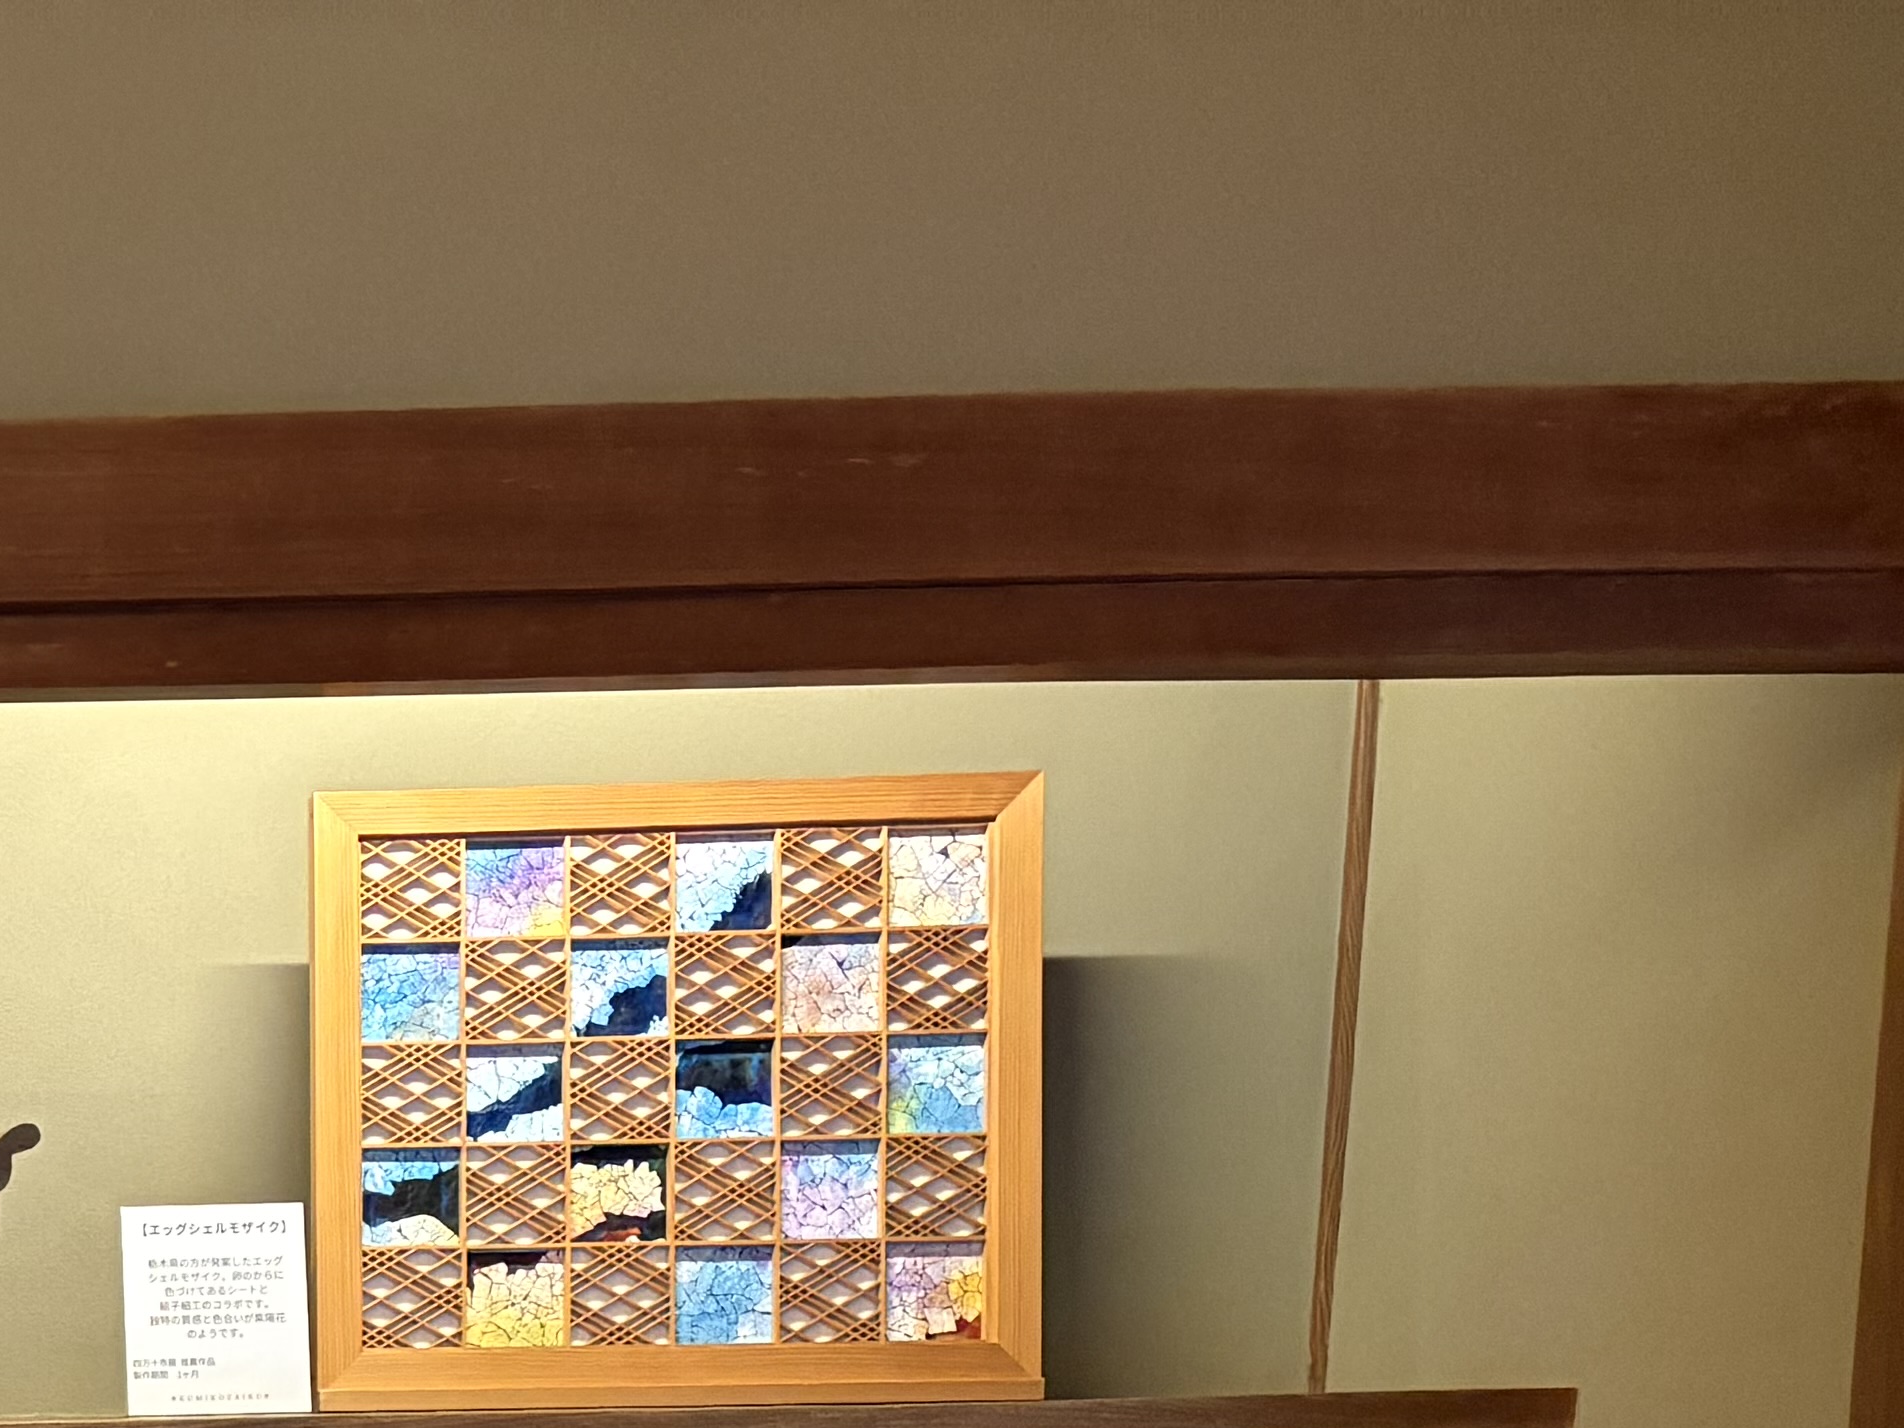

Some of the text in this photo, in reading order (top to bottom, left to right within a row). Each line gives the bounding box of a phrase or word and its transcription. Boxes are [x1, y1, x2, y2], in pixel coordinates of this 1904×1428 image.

[142, 1220, 286, 1237] 【エッグシェルモザイク】
[187, 1328, 244, 1339] のようです。
